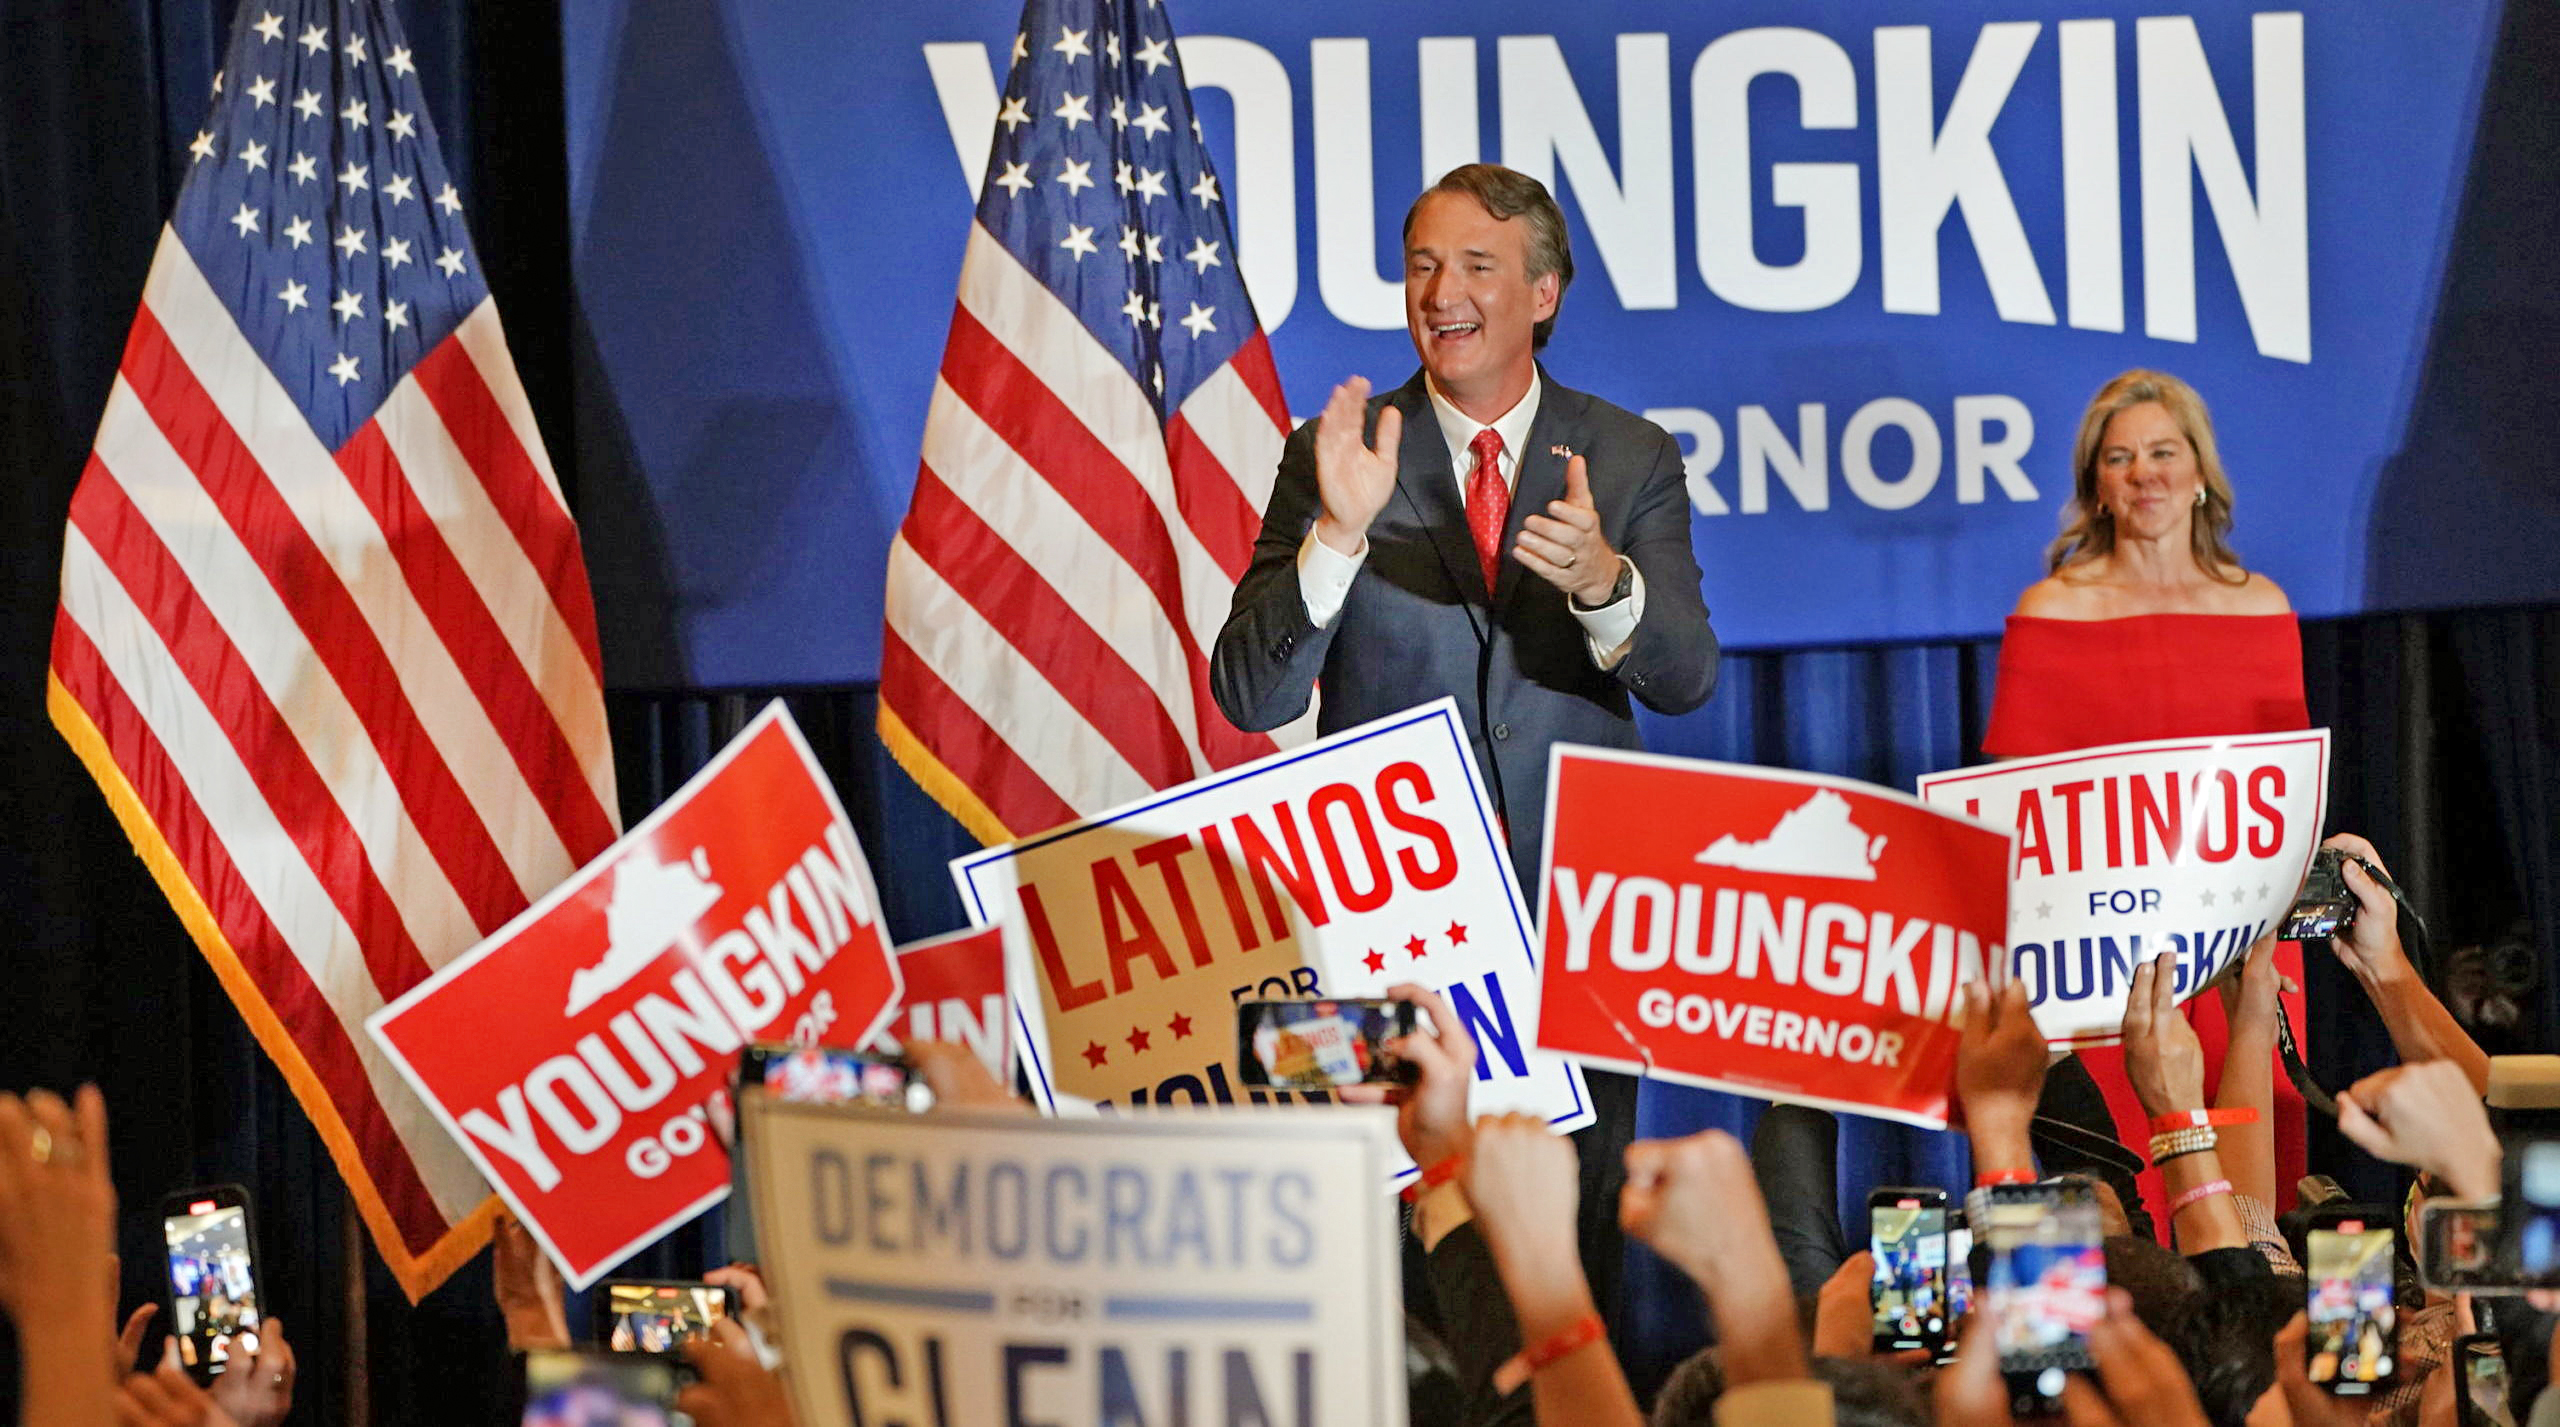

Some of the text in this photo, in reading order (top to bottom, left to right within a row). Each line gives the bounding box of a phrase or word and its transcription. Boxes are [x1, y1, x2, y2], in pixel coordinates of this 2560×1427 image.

[1966, 765, 2286, 880] ATINOS
[1016, 761, 1458, 1013] LATINOS
[2089, 888, 2162, 917] FOR
[459, 823, 874, 1194] YOUNGKIN
[1638, 988, 1904, 1068] GOVERNOR
[810, 1147, 1316, 1269] DEMOCRATS
